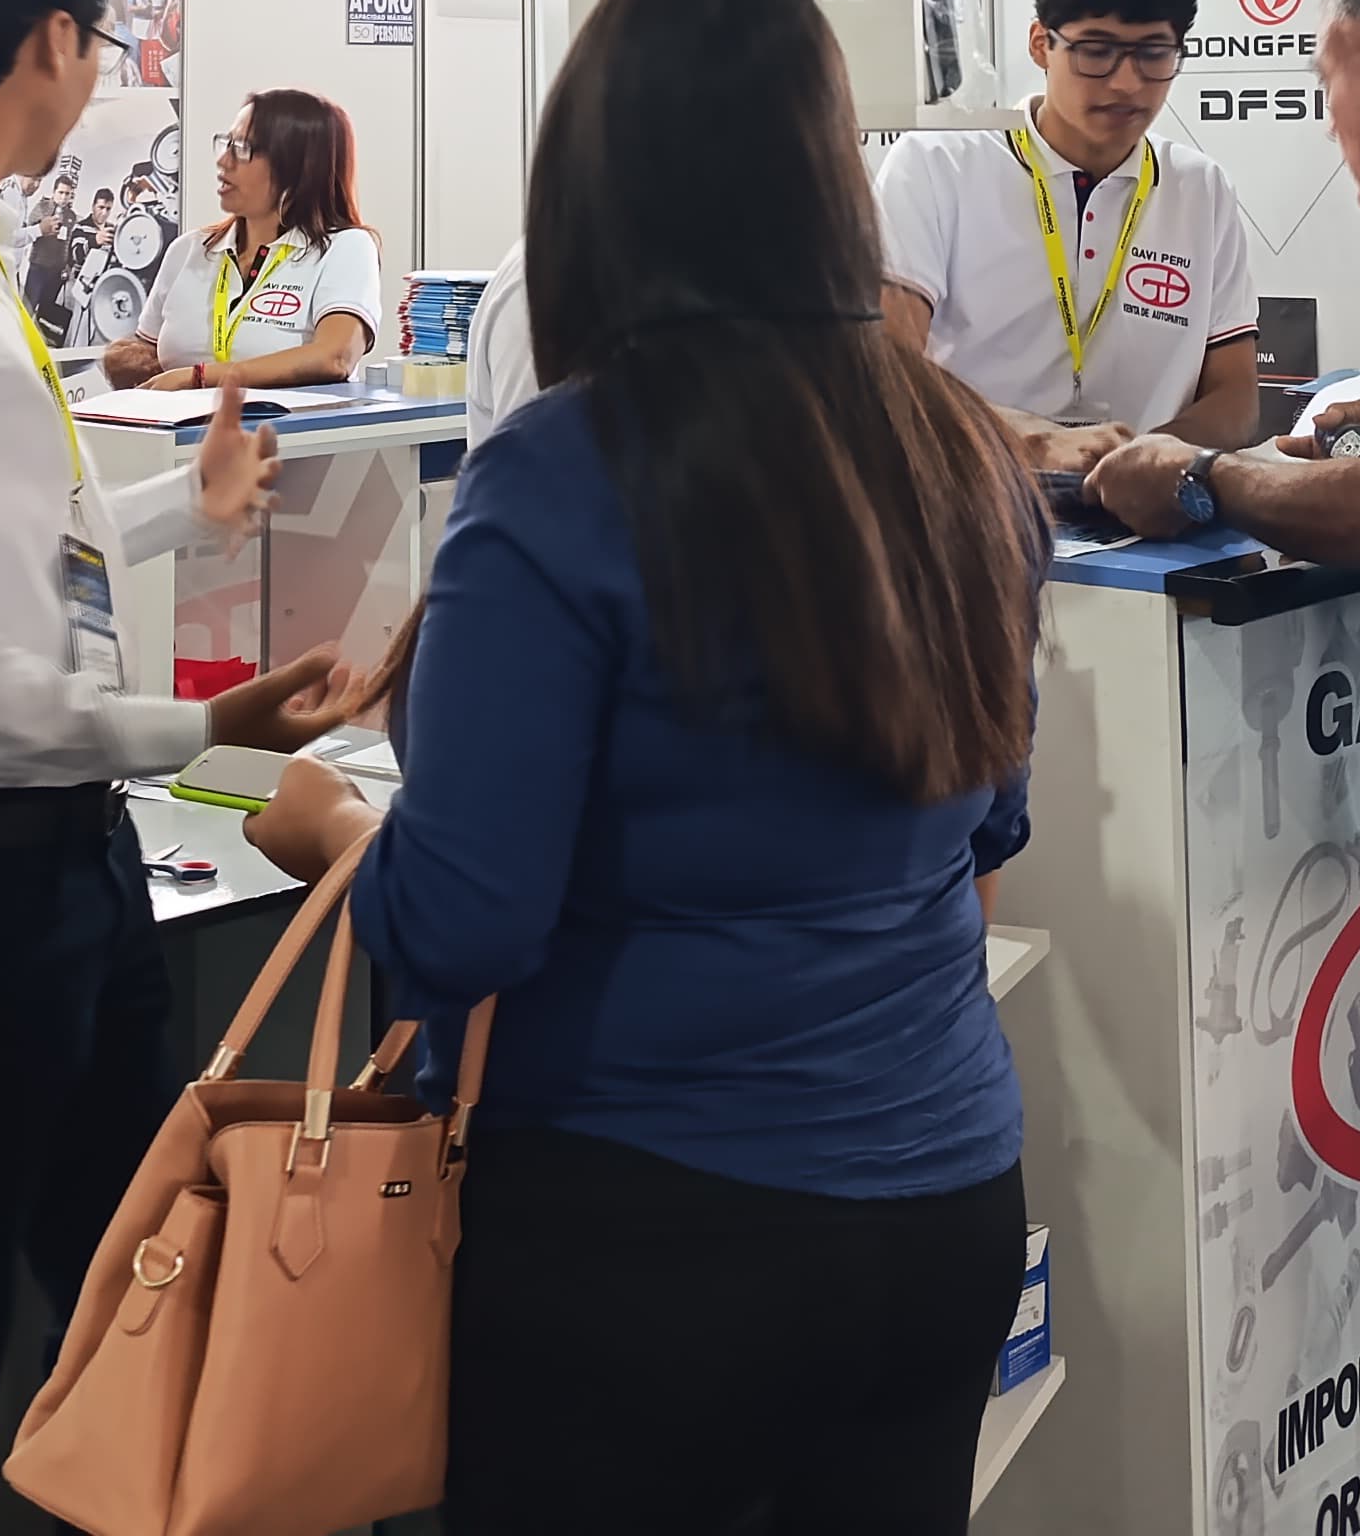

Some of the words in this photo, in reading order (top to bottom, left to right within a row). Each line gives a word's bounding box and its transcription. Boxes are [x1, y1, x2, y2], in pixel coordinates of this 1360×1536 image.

[374, 24, 413, 43] PERSONAS
[1183, 34, 1317, 58] DONGFE
[1131, 246, 1157, 262] GAVI
[263, 281, 279, 290] AVI
